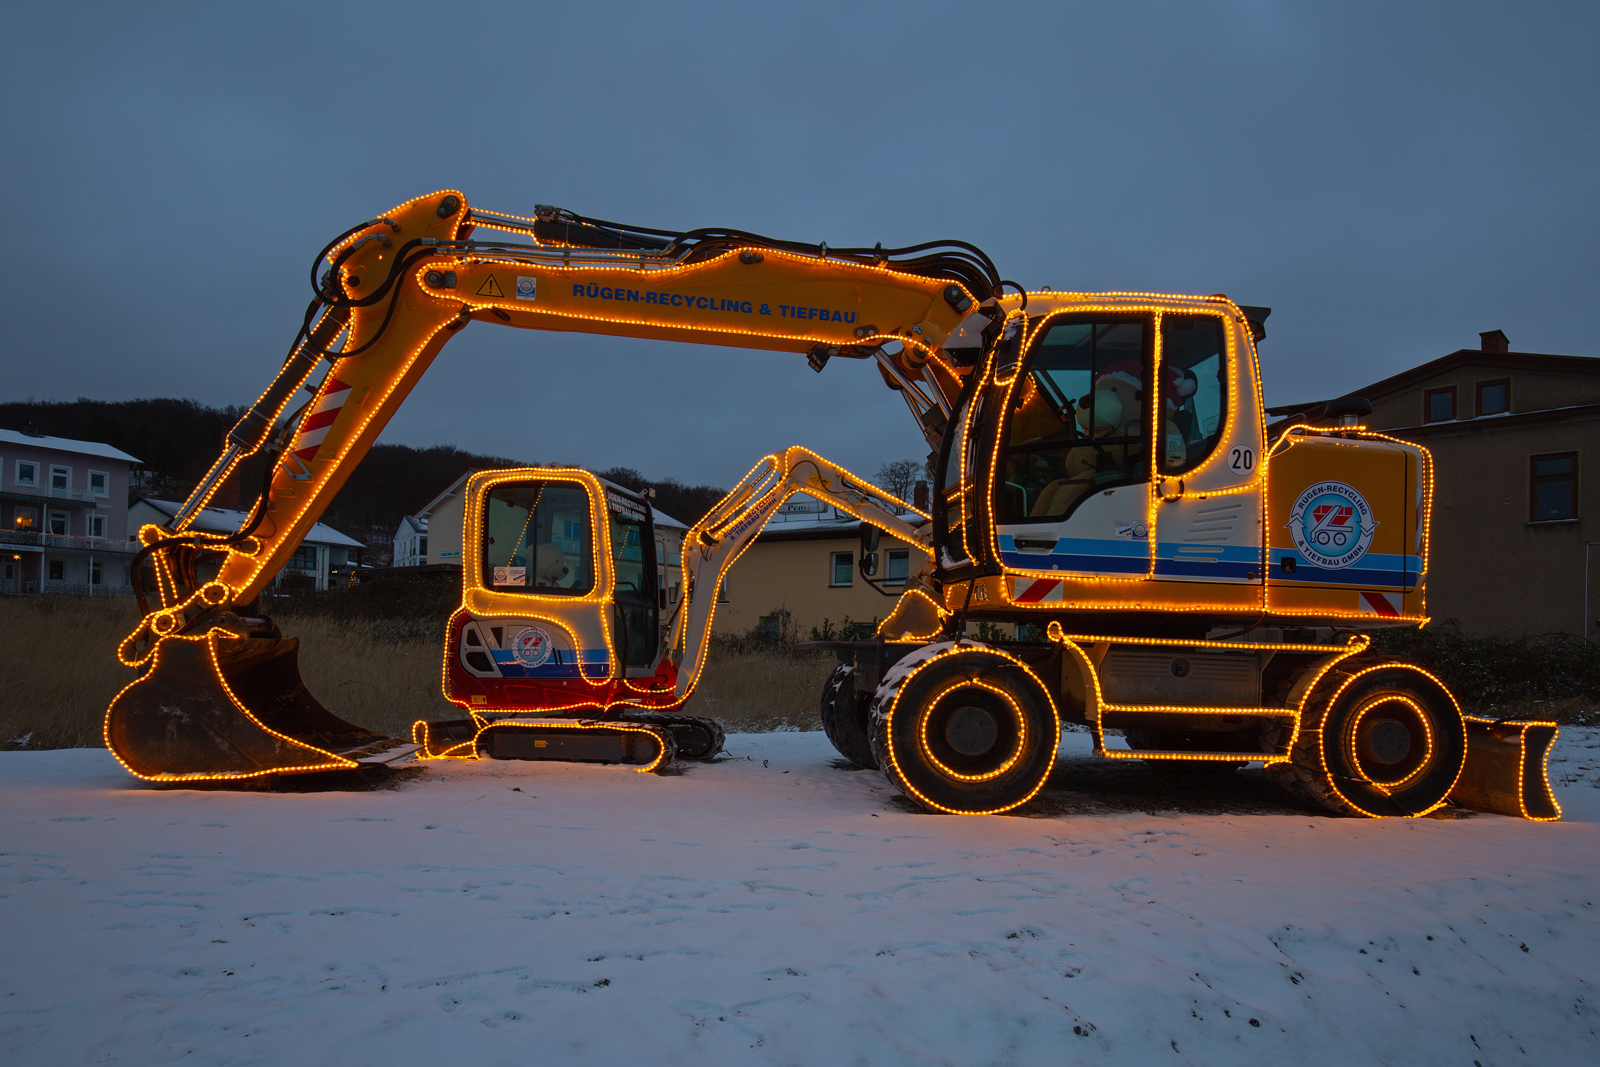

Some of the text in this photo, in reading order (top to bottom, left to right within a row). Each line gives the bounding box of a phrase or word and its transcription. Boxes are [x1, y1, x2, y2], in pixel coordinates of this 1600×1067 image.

[572, 282, 753, 314] RÜGEN-RECYCLING
[759, 303, 772, 316] &
[779, 304, 856, 324] TIEFBAU
[1232, 449, 1252, 470] 20
[787, 504, 820, 512] Pensio
[1298, 485, 1367, 515] RÜGEN-RECYCLING
[735, 514, 760, 536] TIEFBAU
[760, 497, 777, 515] GMBH
[1304, 547, 1339, 566] TIEFBAU
[1342, 545, 1364, 564] GMBH
